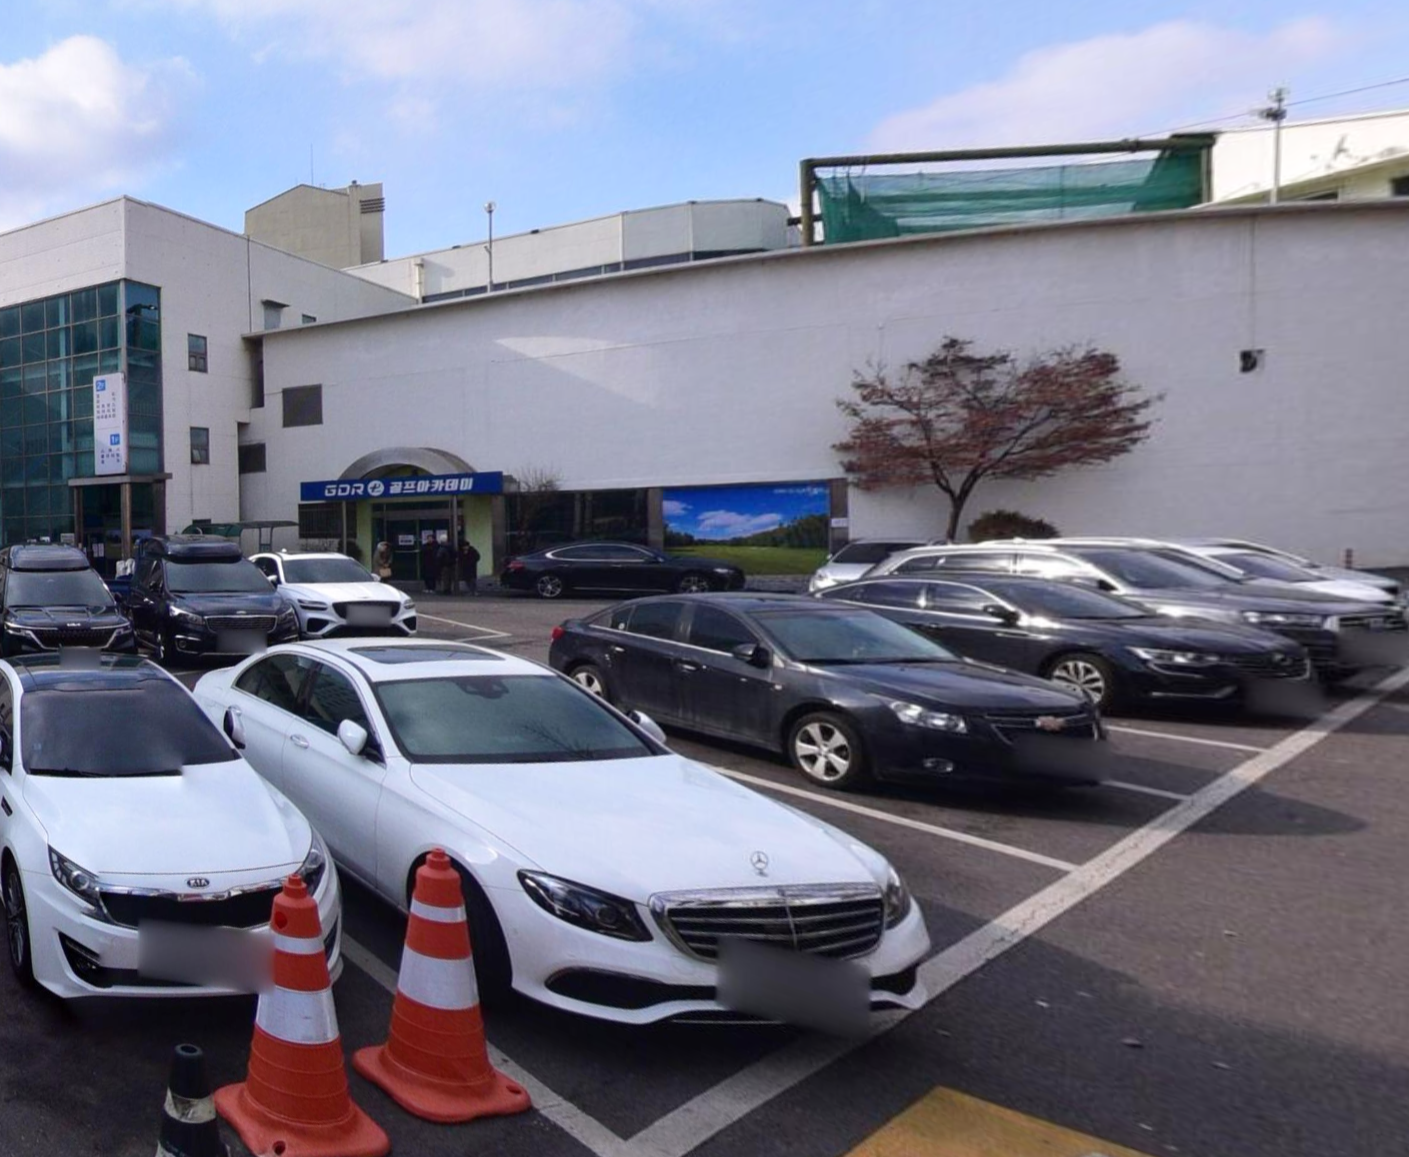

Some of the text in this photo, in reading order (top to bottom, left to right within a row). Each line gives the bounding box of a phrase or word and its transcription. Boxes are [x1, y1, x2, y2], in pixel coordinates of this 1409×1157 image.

[325, 478, 473, 497] GDR 골프아카데미
[188, 878, 209, 888] KIA
